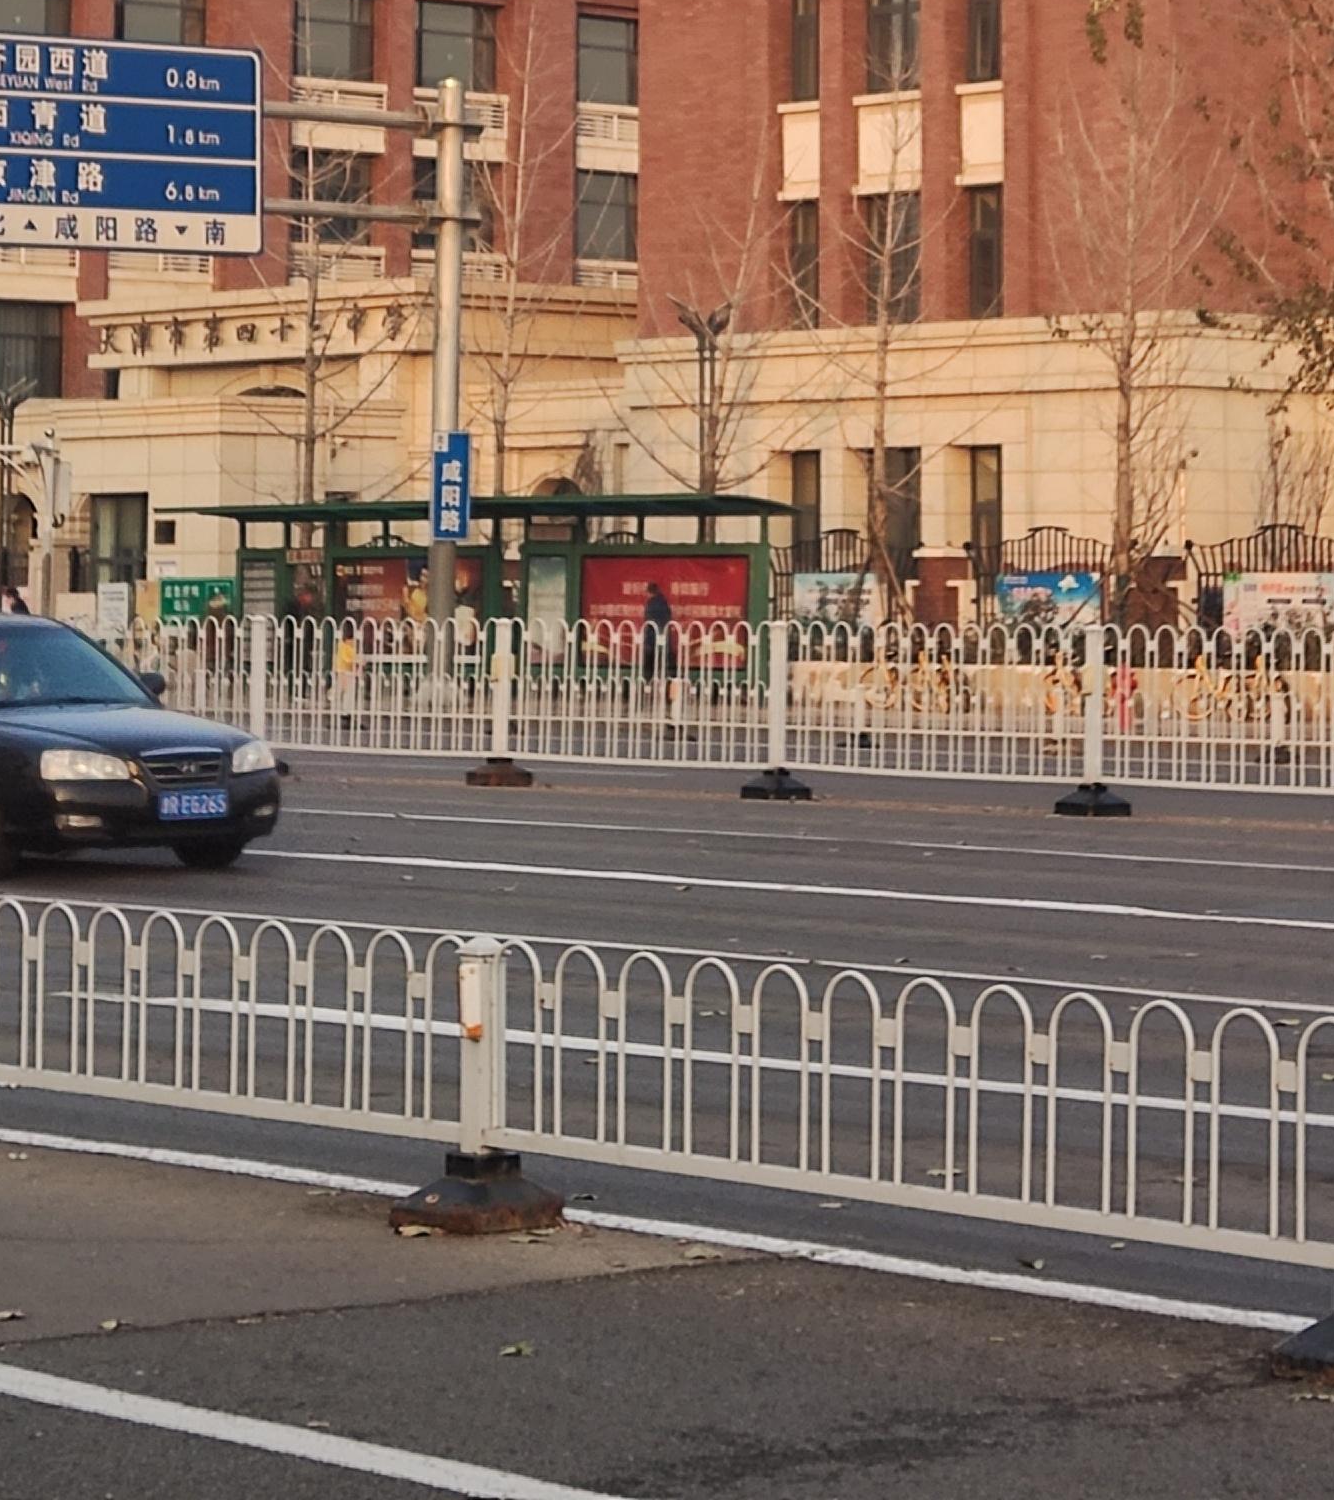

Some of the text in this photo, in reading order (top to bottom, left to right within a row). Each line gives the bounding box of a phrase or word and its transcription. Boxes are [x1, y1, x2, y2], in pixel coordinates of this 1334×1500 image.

[54, 213, 157, 243] 咸阳路
[204, 218, 227, 245] 南
[440, 460, 462, 533] 咸阳路
